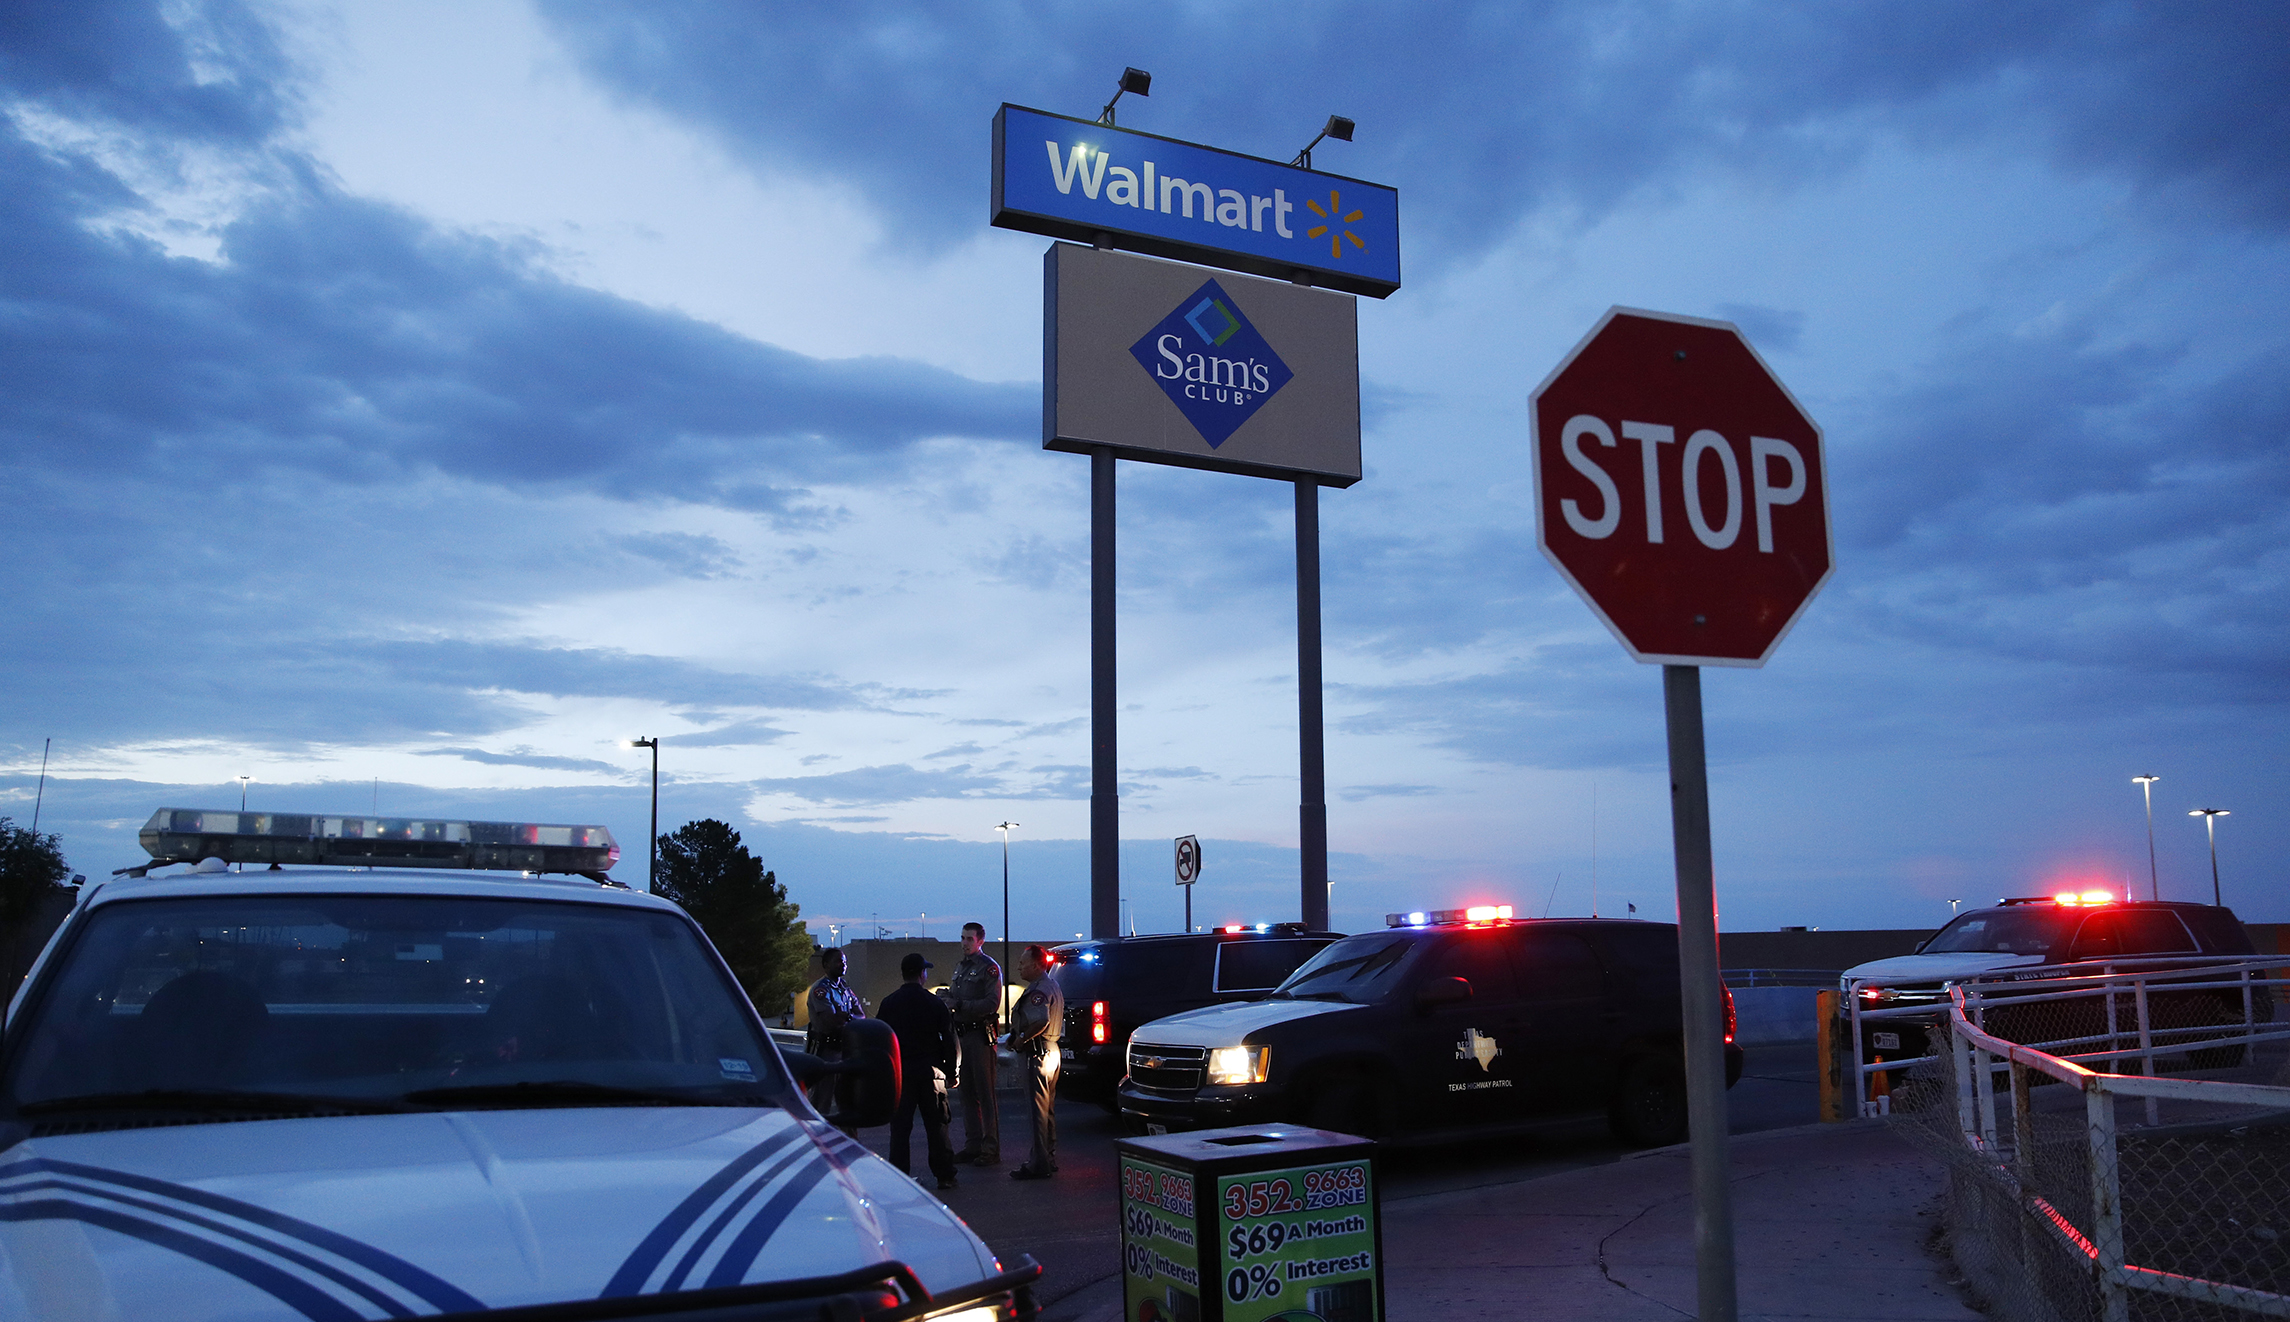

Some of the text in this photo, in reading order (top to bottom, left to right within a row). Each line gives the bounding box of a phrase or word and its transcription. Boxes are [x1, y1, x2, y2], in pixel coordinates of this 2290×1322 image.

[1045, 140, 1293, 239] Walmart
[1156, 333, 1270, 394] Sam's
[1184, 384, 1244, 406] CLUB
[1559, 413, 1808, 554] STOP
[2014, 973, 2039, 981] STATE
[1448, 1079, 1513, 1092] TEXAS HIGHWAY PATROL
[1160, 1173, 1193, 1201] 9663
[1304, 1167, 1365, 1193] 9663
[1162, 1195, 1194, 1218] ZONE
[1305, 1188, 1366, 1210] ZONE
[1127, 1203, 1194, 1246] $69 A Month
[1229, 1216, 1365, 1260] $69 A Month
[1127, 1242, 1198, 1286] 0% Interest
[1227, 1252, 1370, 1302] 0% Interest
